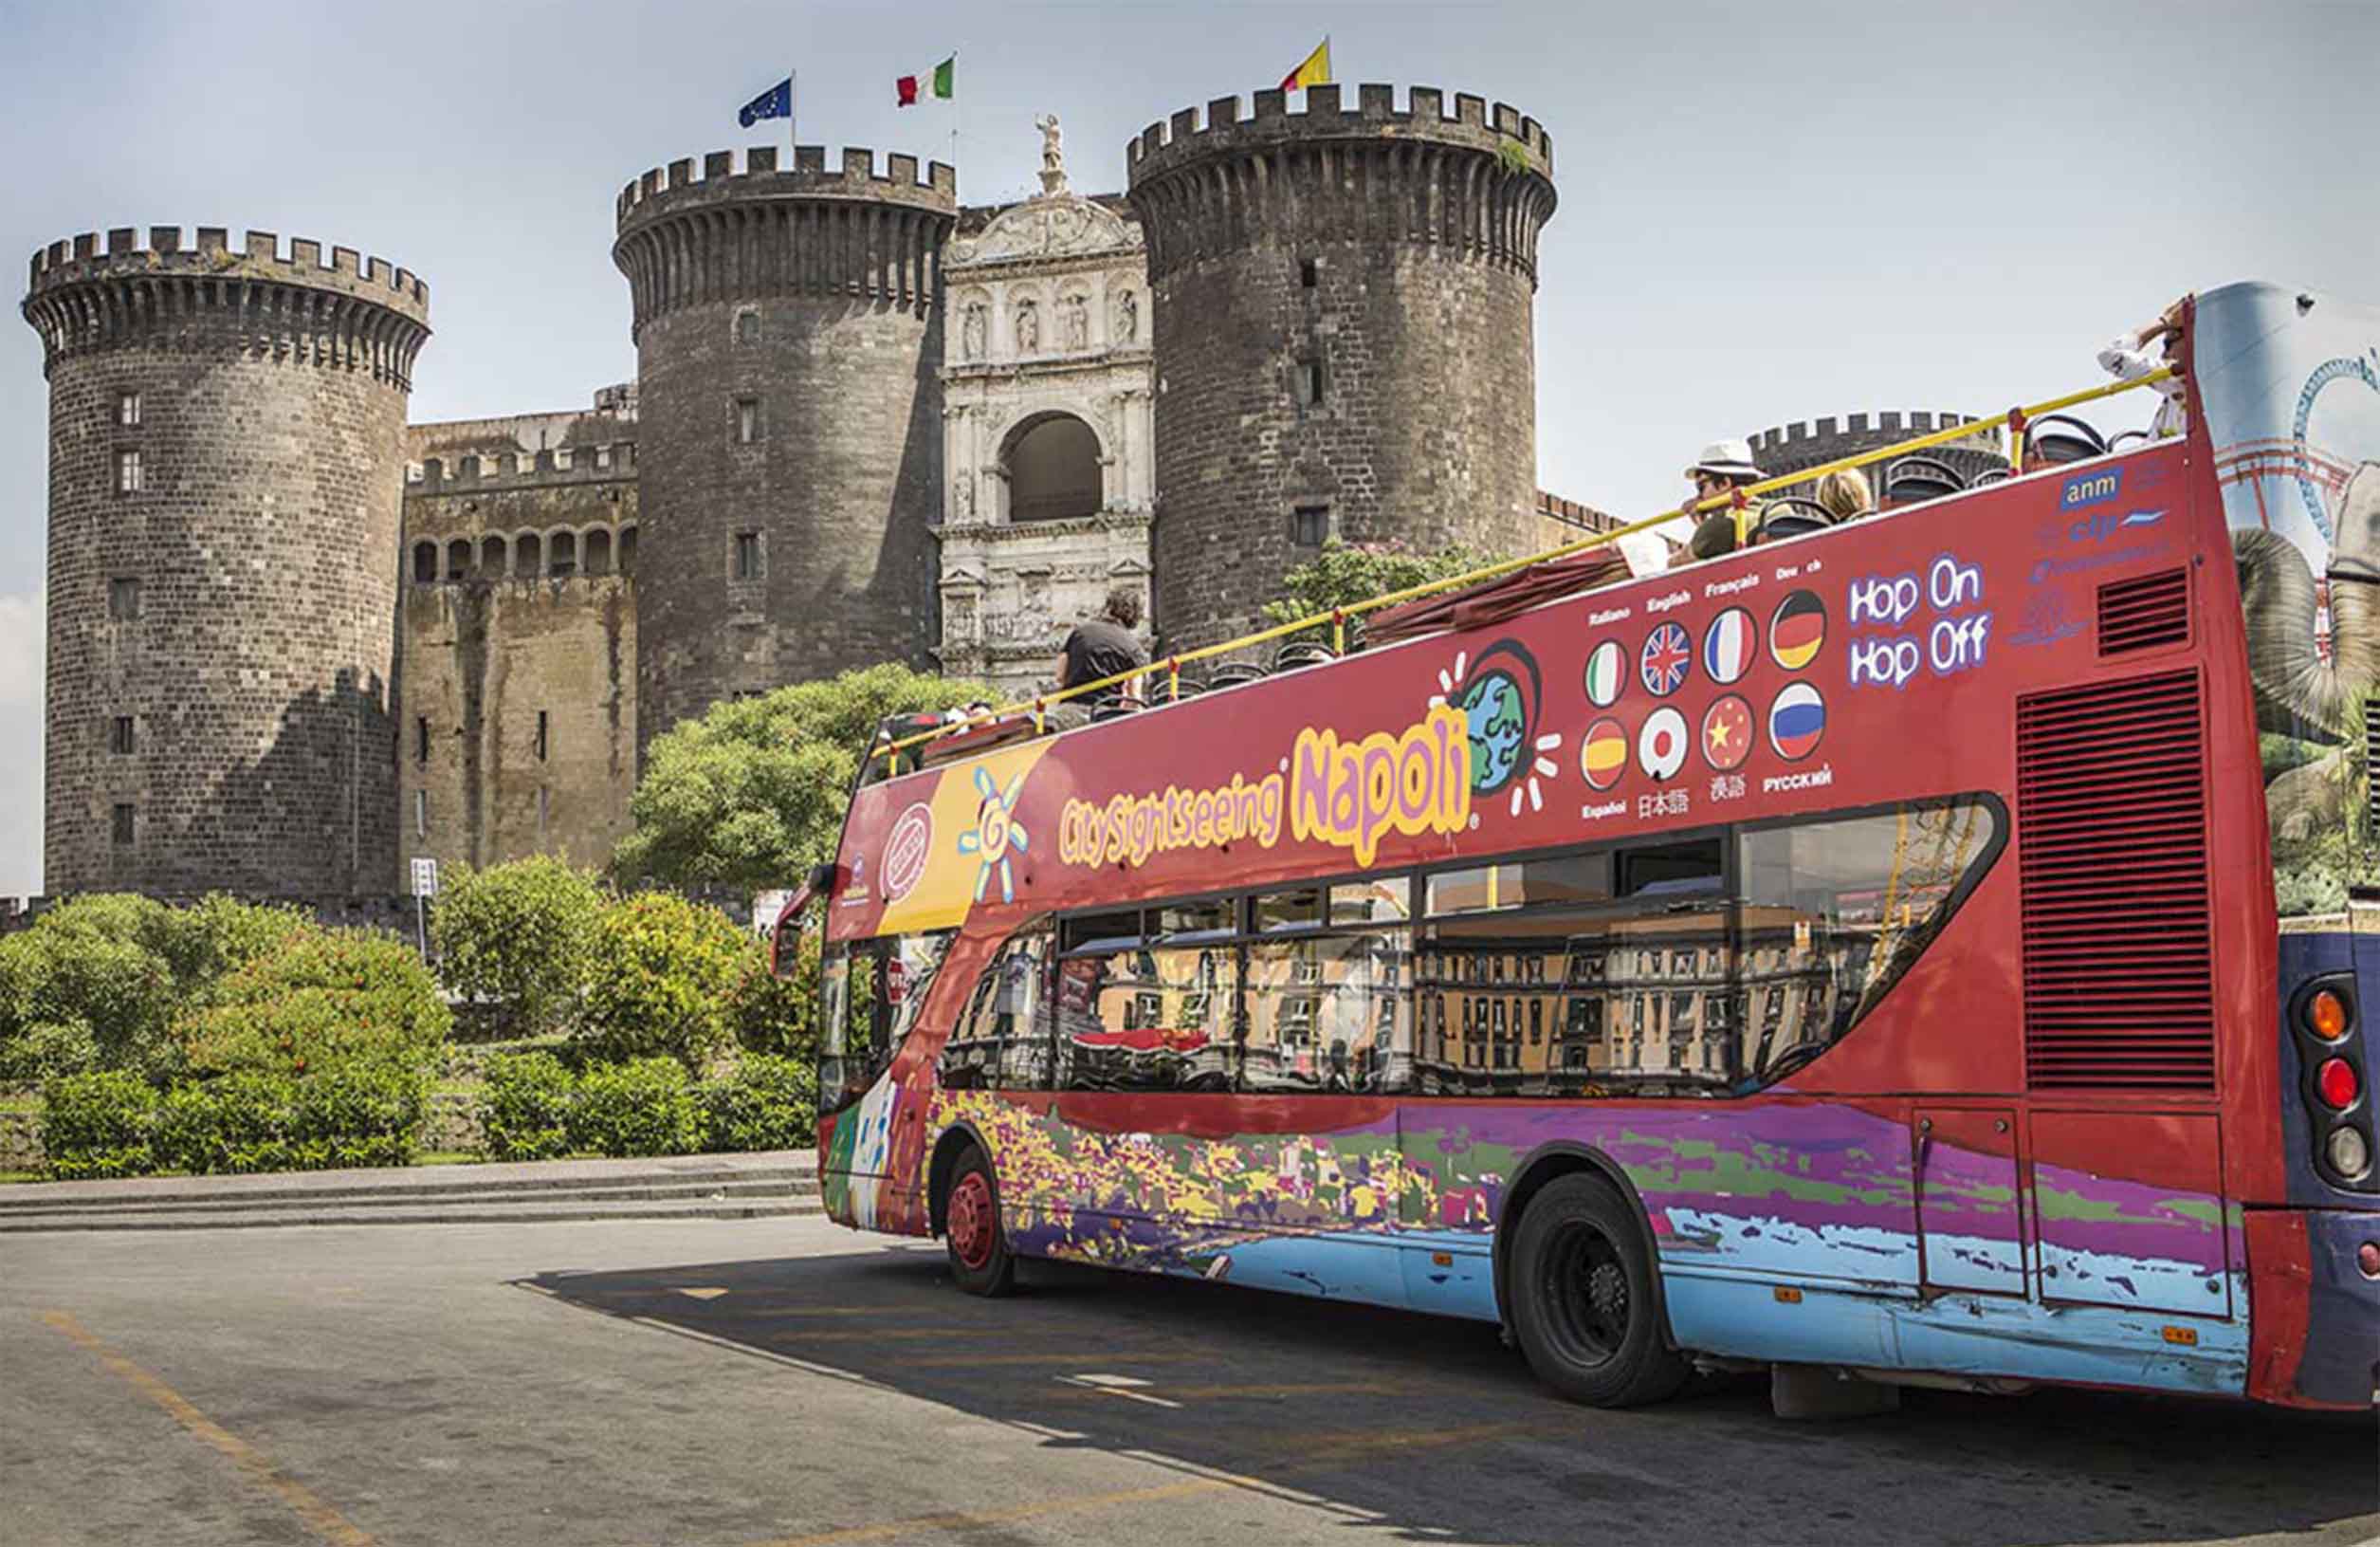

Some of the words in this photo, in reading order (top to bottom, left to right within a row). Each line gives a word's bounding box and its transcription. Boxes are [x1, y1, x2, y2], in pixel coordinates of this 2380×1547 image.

[2066, 475, 2116, 504] anm
[1704, 572, 1761, 599] Français
[1848, 576, 1921, 625] Hop
[1929, 557, 1981, 609] On
[1645, 590, 1692, 614] English
[1848, 637, 1921, 687] Hop
[1929, 614, 1989, 672] Off
[1291, 705, 1472, 868] Napoli
[1763, 762, 1834, 794] РУССКИЙ
[1581, 799, 1627, 820] Español
[1638, 788, 1690, 820] 日本語
